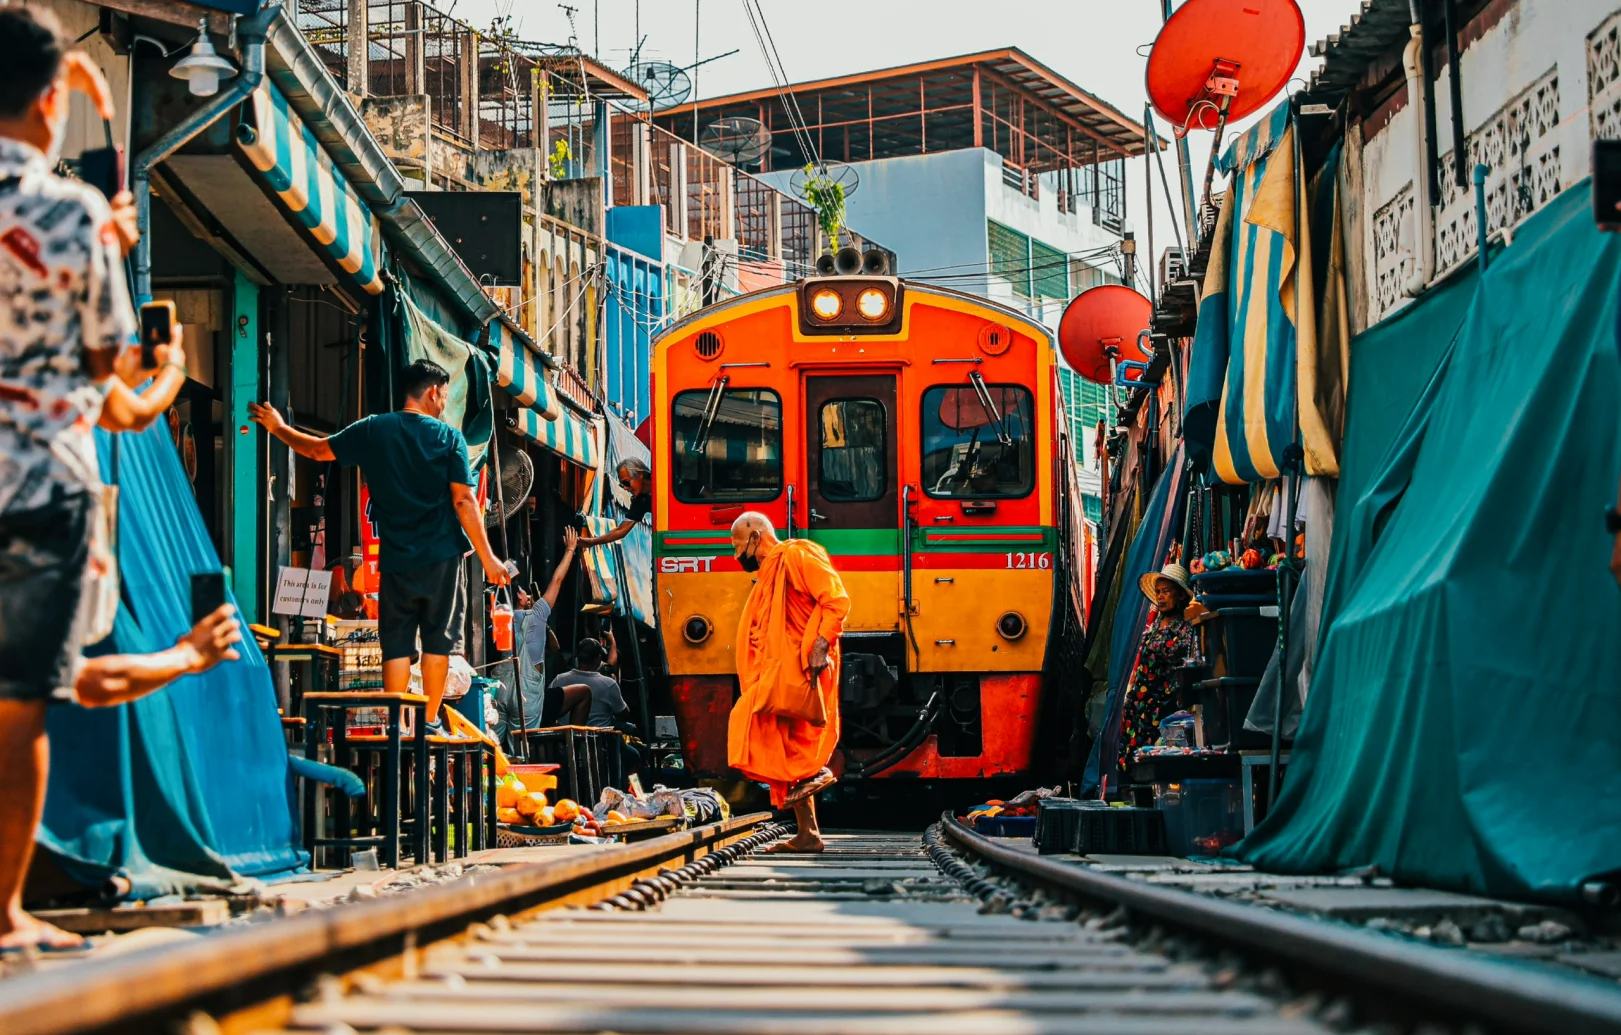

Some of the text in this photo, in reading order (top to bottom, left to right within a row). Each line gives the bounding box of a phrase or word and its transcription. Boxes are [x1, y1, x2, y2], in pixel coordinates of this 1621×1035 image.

[661, 556, 716, 572] SRT
[1005, 551, 1049, 571] 1216
[318, 582, 328, 590] for
[280, 596, 324, 607] customrs only
